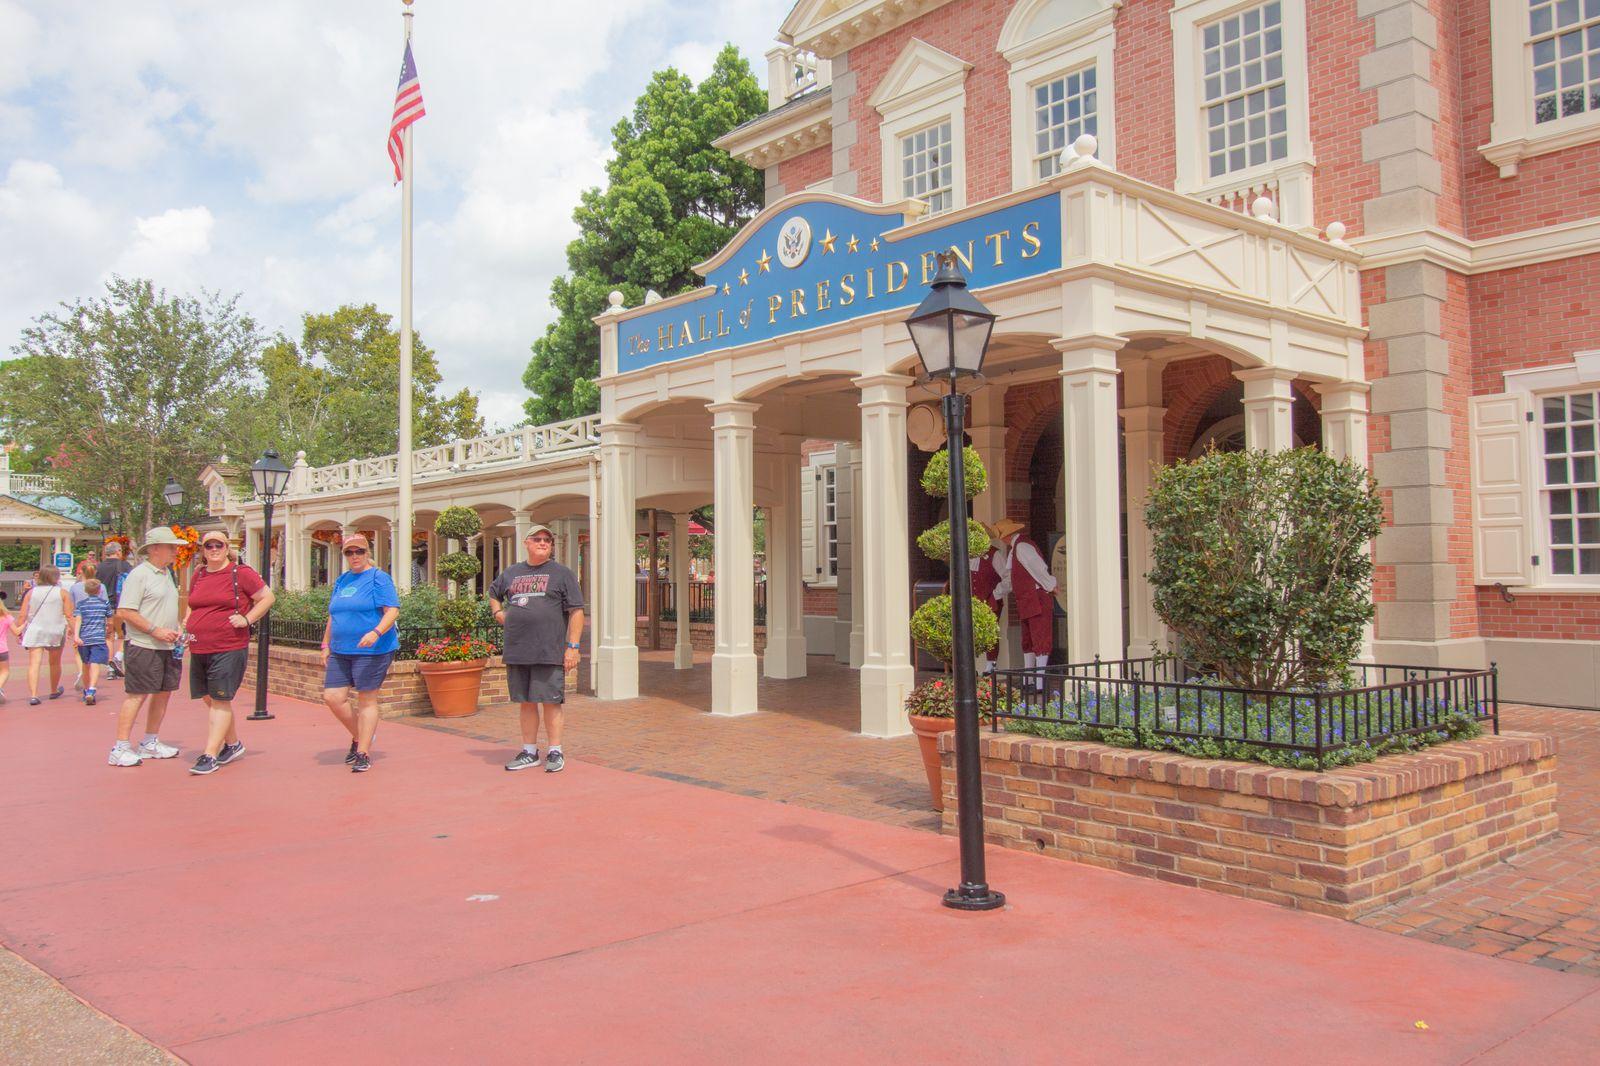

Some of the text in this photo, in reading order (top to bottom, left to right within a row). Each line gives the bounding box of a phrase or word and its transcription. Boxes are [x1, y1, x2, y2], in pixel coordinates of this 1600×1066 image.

[625, 221, 1042, 356] The HALL of PRESIDENTS
